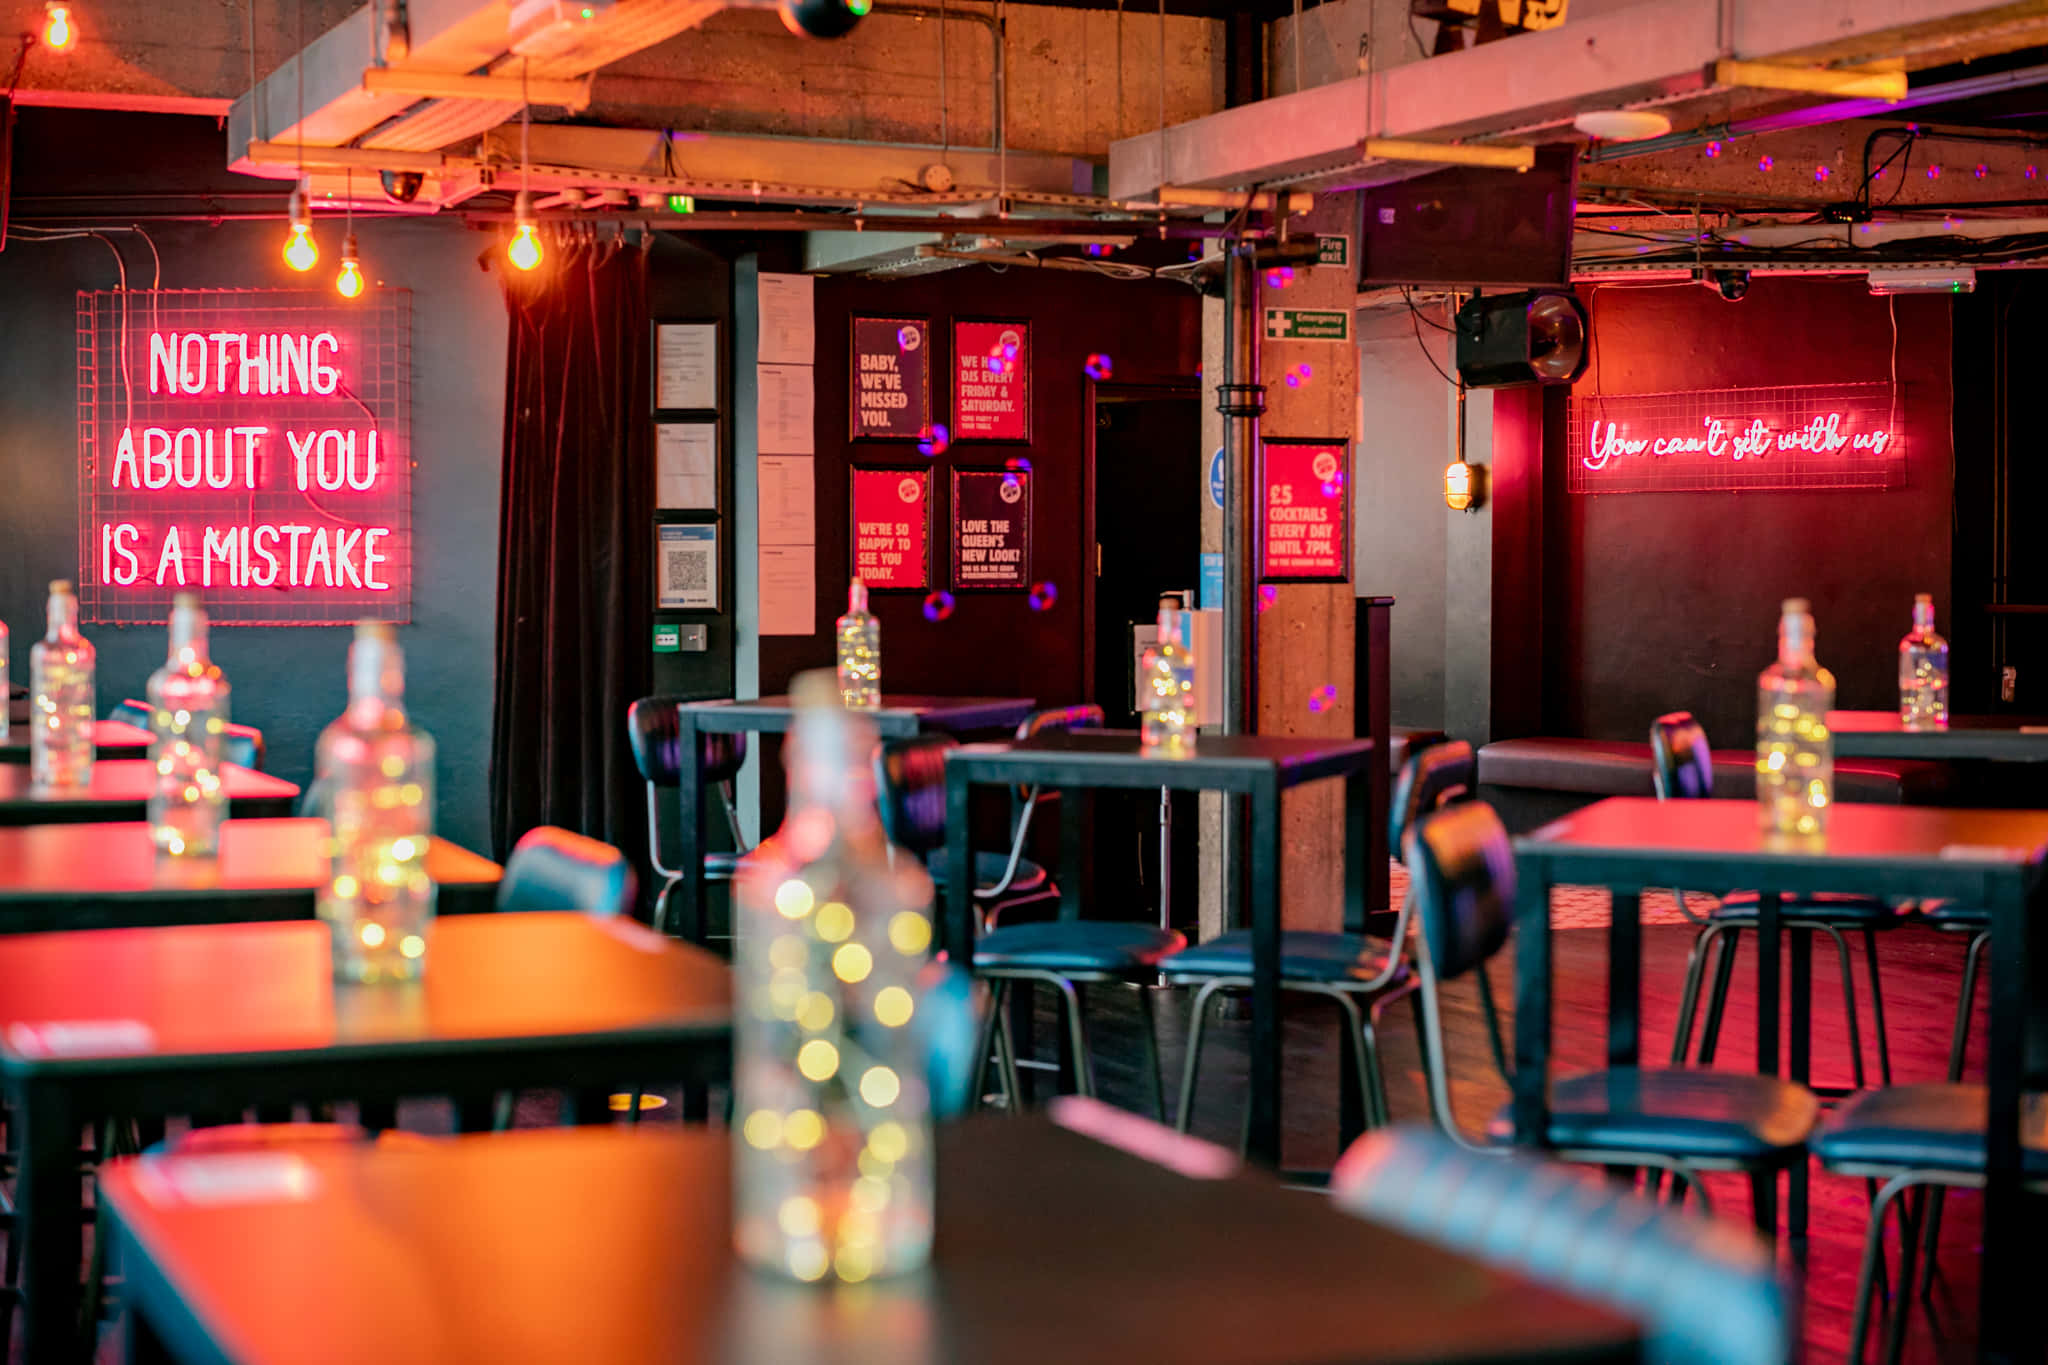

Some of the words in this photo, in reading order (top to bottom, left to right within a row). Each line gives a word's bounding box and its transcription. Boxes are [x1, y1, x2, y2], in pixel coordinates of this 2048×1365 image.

[1320, 238, 1342, 250] Fire
[1320, 251, 1342, 262] exit
[150, 332, 338, 395] NOTHING
[860, 354, 899, 373] BABY,
[961, 355, 978, 368] WE
[860, 373, 902, 390] WE'VE
[982, 370, 1014, 383] EVERY
[961, 385, 997, 398] FRIDAY
[861, 391, 908, 408] MISSED
[961, 399, 1016, 412] SATURDAY.
[861, 410, 892, 427] YOU.
[1583, 420, 1648, 470] You
[1653, 416, 1727, 456] can't
[1732, 419, 1771, 461] sit
[1777, 413, 1848, 454] with
[1853, 432, 1888, 455] us
[112, 427, 268, 489] ABOUT
[286, 429, 377, 491] YOU
[1270, 484, 1293, 505] £5
[1270, 507, 1327, 522] COCKTAILS
[859, 522, 892, 536] WE'RE
[896, 523, 909, 536] SO
[962, 520, 988, 533] LOVE
[990, 520, 1010, 533] THE
[1270, 524, 1307, 538] EVERY
[1310, 524, 1333, 538] DAY
[858, 537, 894, 550] HAPPY
[897, 538, 911, 551] TO
[962, 534, 1005, 548] QUEEN'S
[1270, 540, 1302, 555] UNTIL
[1306, 540, 1334, 555] 7PM.
[102, 524, 139, 585] IS
[156, 526, 186, 586] A
[203, 525, 390, 590] MISTAKE
[858, 552, 878, 565] SEE
[881, 552, 902, 565] YOU
[962, 549, 987, 562] NEW
[858, 567, 894, 580] TODAY.
